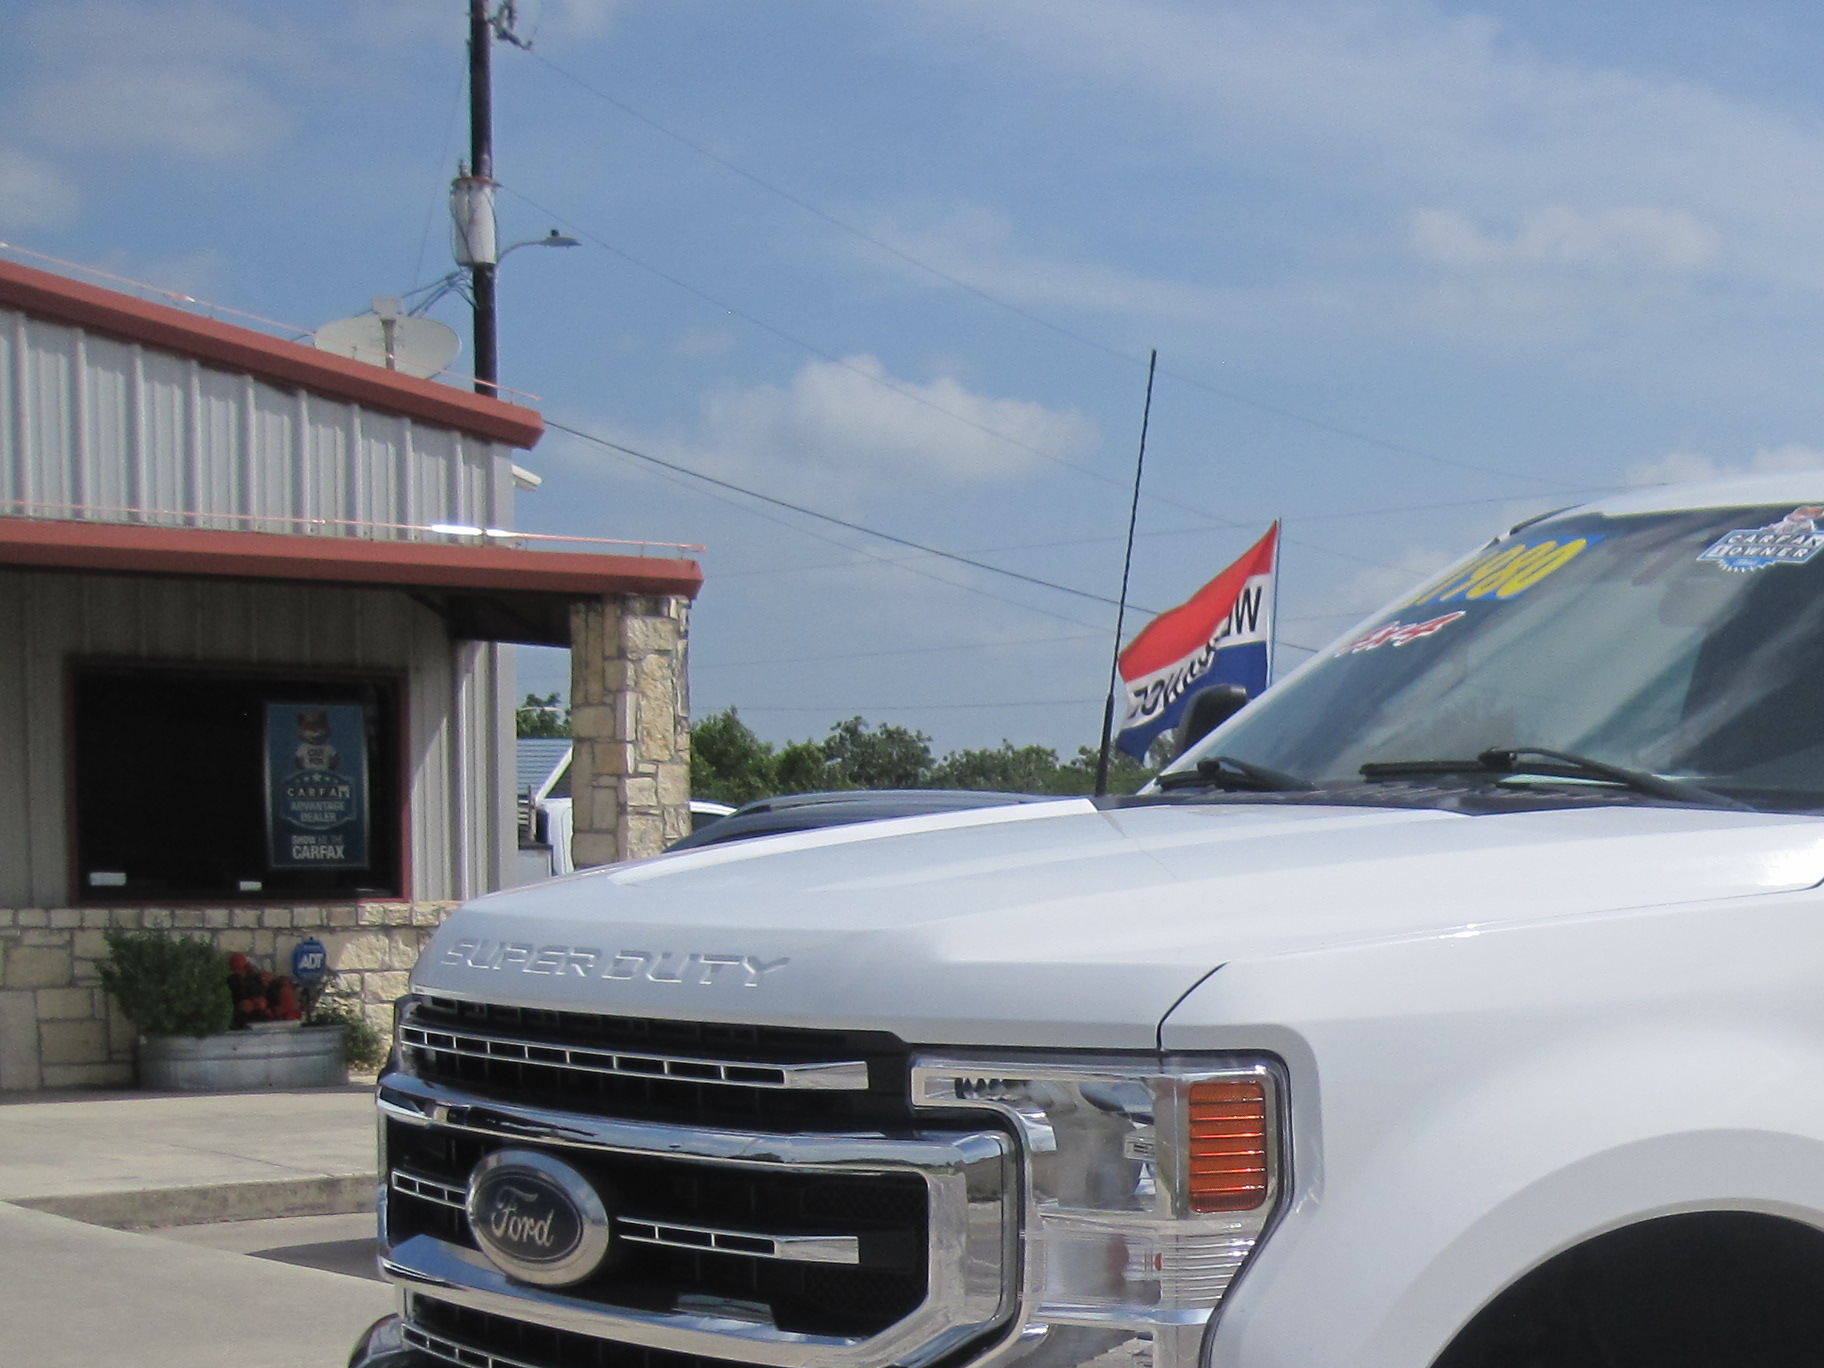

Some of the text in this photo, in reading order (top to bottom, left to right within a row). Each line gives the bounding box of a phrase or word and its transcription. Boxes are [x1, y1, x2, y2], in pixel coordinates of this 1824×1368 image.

[1729, 546, 1808, 558] OWNER
[290, 801, 345, 811] ADVANTAGE
[300, 812, 337, 822] DEALER
[292, 845, 345, 860] CARFAX
[298, 953, 324, 969] ADT
[440, 938, 791, 988] SUPER DUTY
[491, 1185, 555, 1247] Ford
